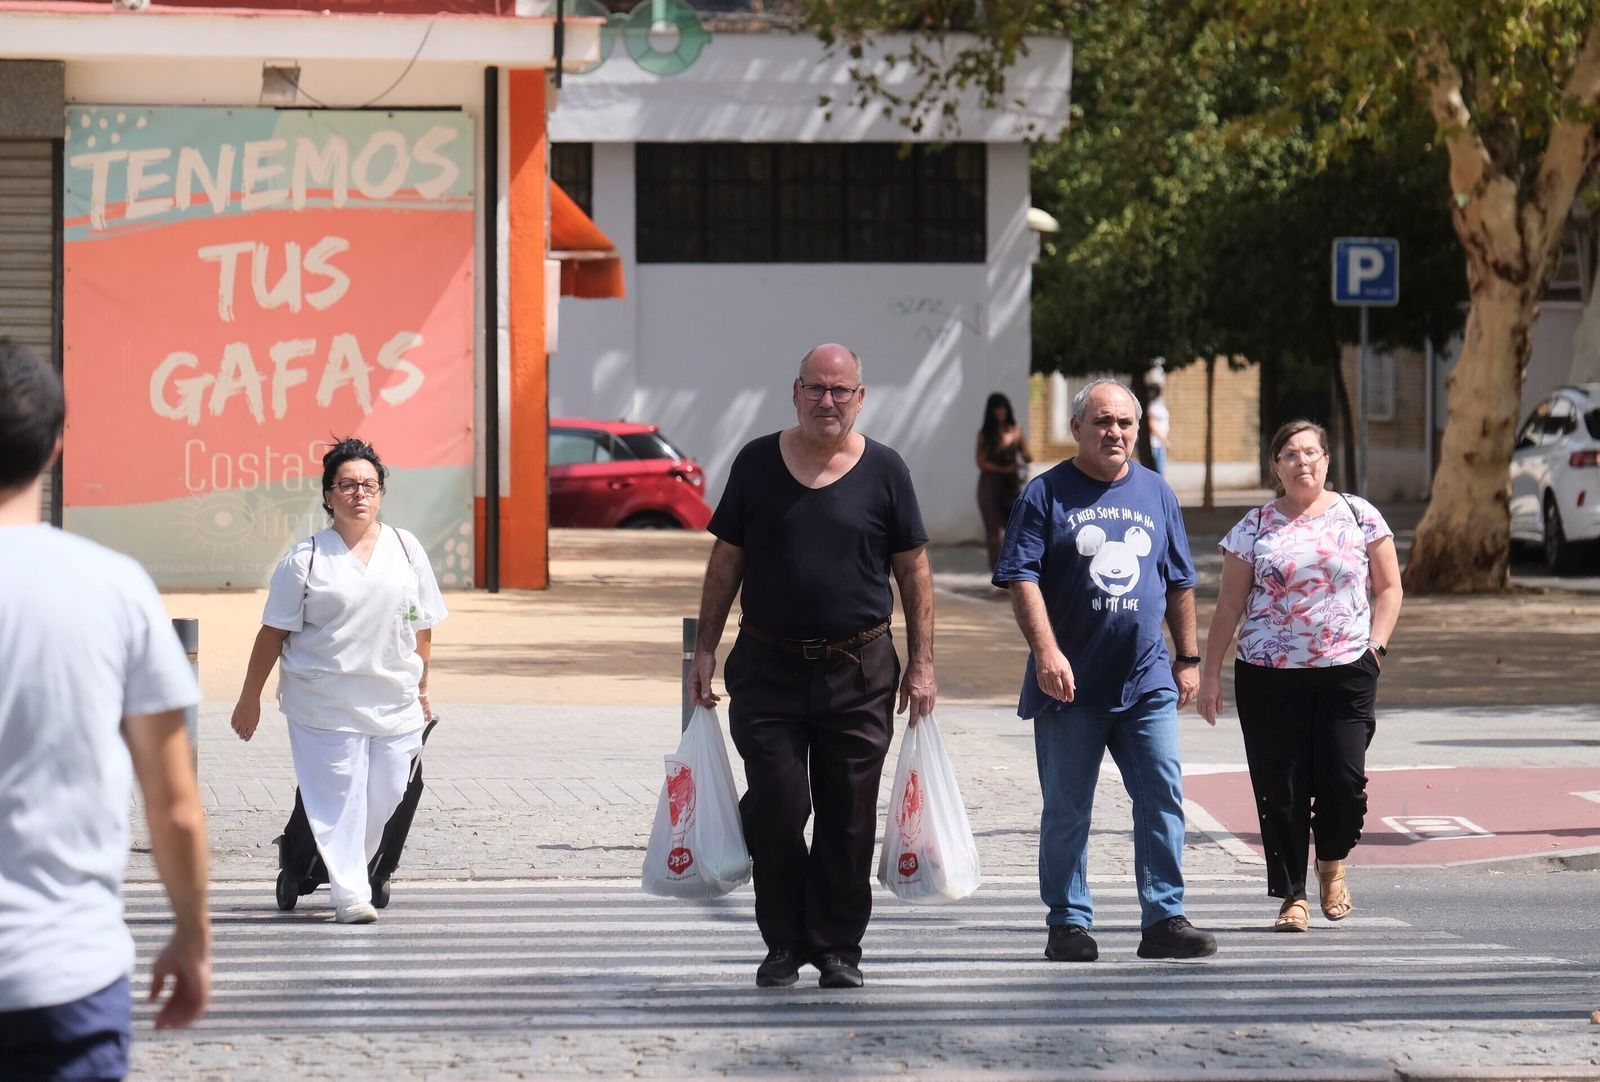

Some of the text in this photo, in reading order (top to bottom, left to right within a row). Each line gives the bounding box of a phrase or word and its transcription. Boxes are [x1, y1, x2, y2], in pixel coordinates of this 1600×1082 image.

[70, 125, 460, 230] TENEMOS
[197, 235, 351, 323] TUS
[1348, 247, 1385, 295] P
[149, 330, 426, 427] GAFAS
[1067, 507, 1154, 531] I NEED SOME HA HA HA
[1091, 596, 1139, 613] IN MY LIFE
